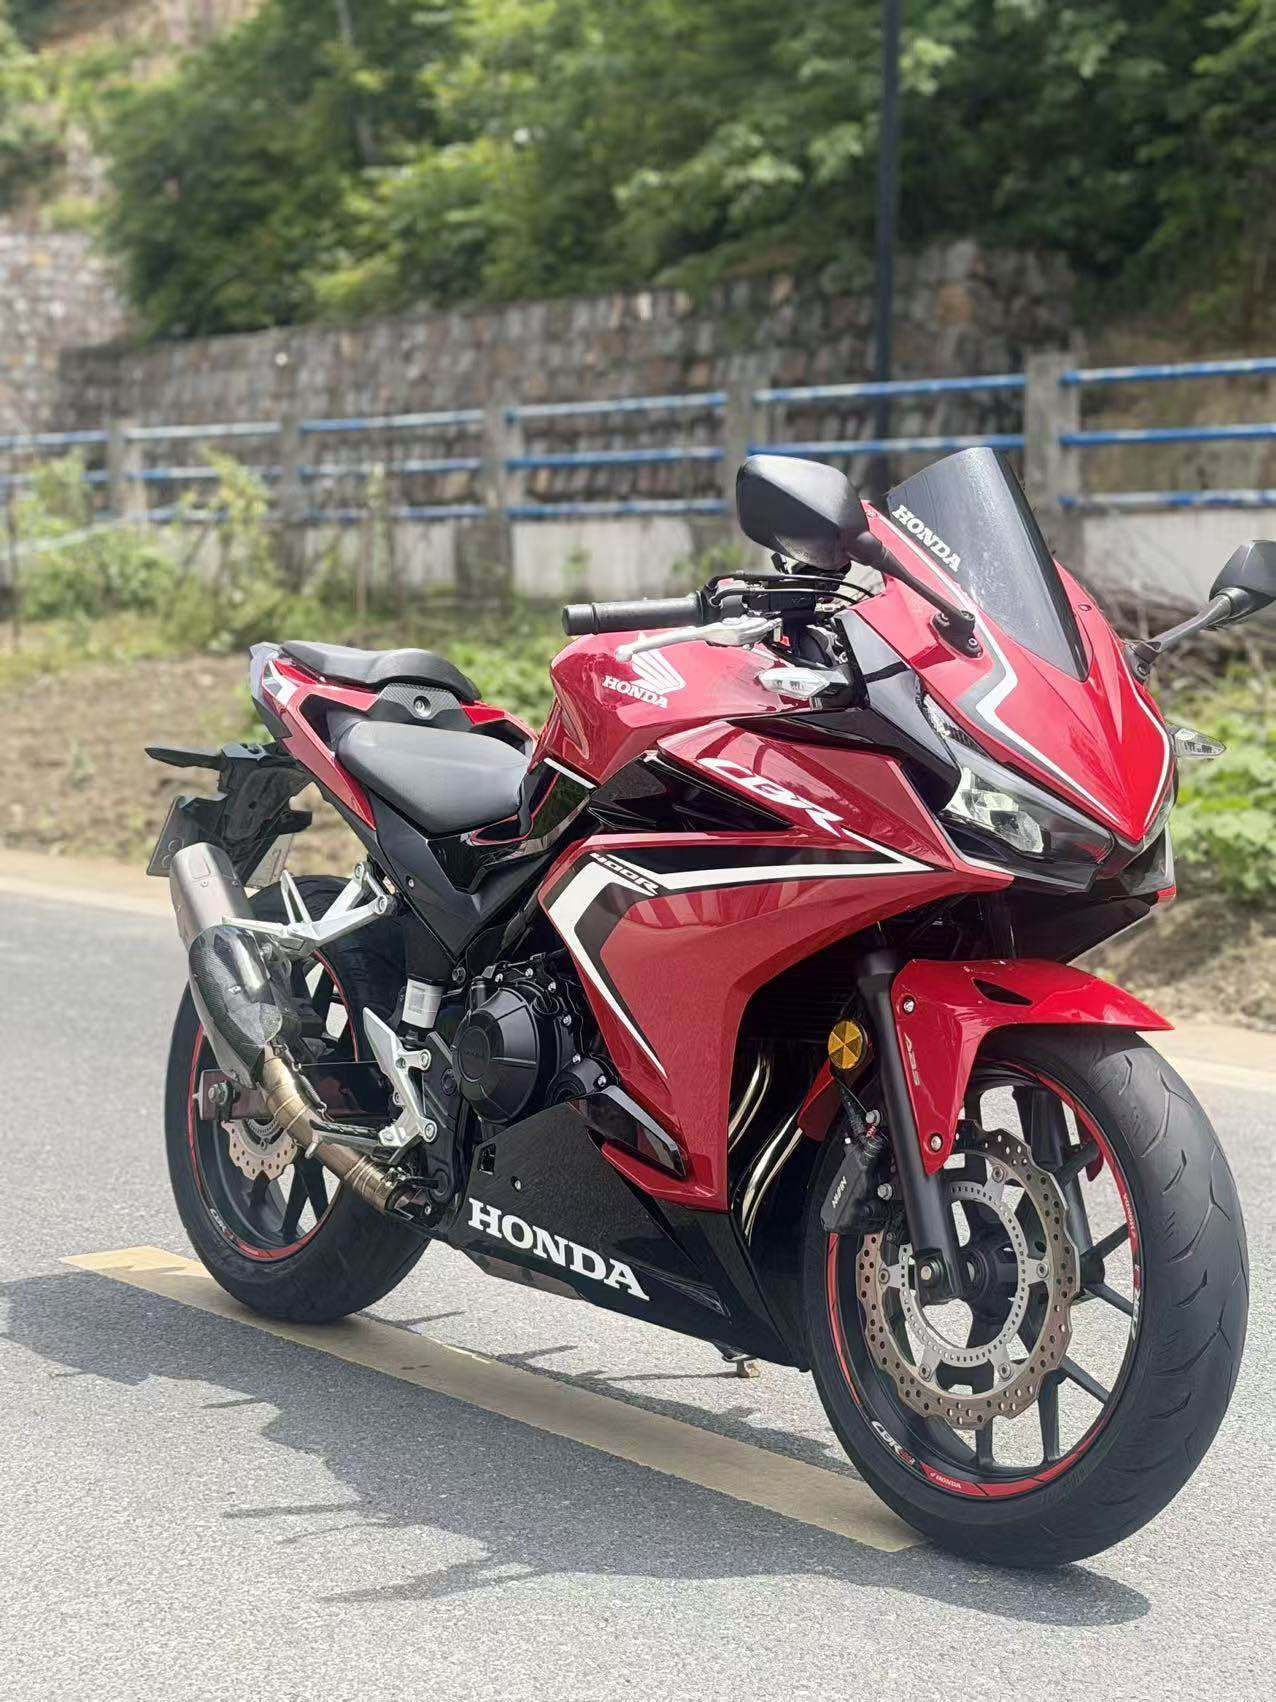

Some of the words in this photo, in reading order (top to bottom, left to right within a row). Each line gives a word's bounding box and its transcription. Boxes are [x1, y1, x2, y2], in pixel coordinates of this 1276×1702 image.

[892, 505, 961, 573] HONDA
[602, 675, 668, 709] HONDA
[696, 757, 845, 838] CBR
[589, 852, 660, 895] 400R
[468, 1197, 650, 1302] HONDA
